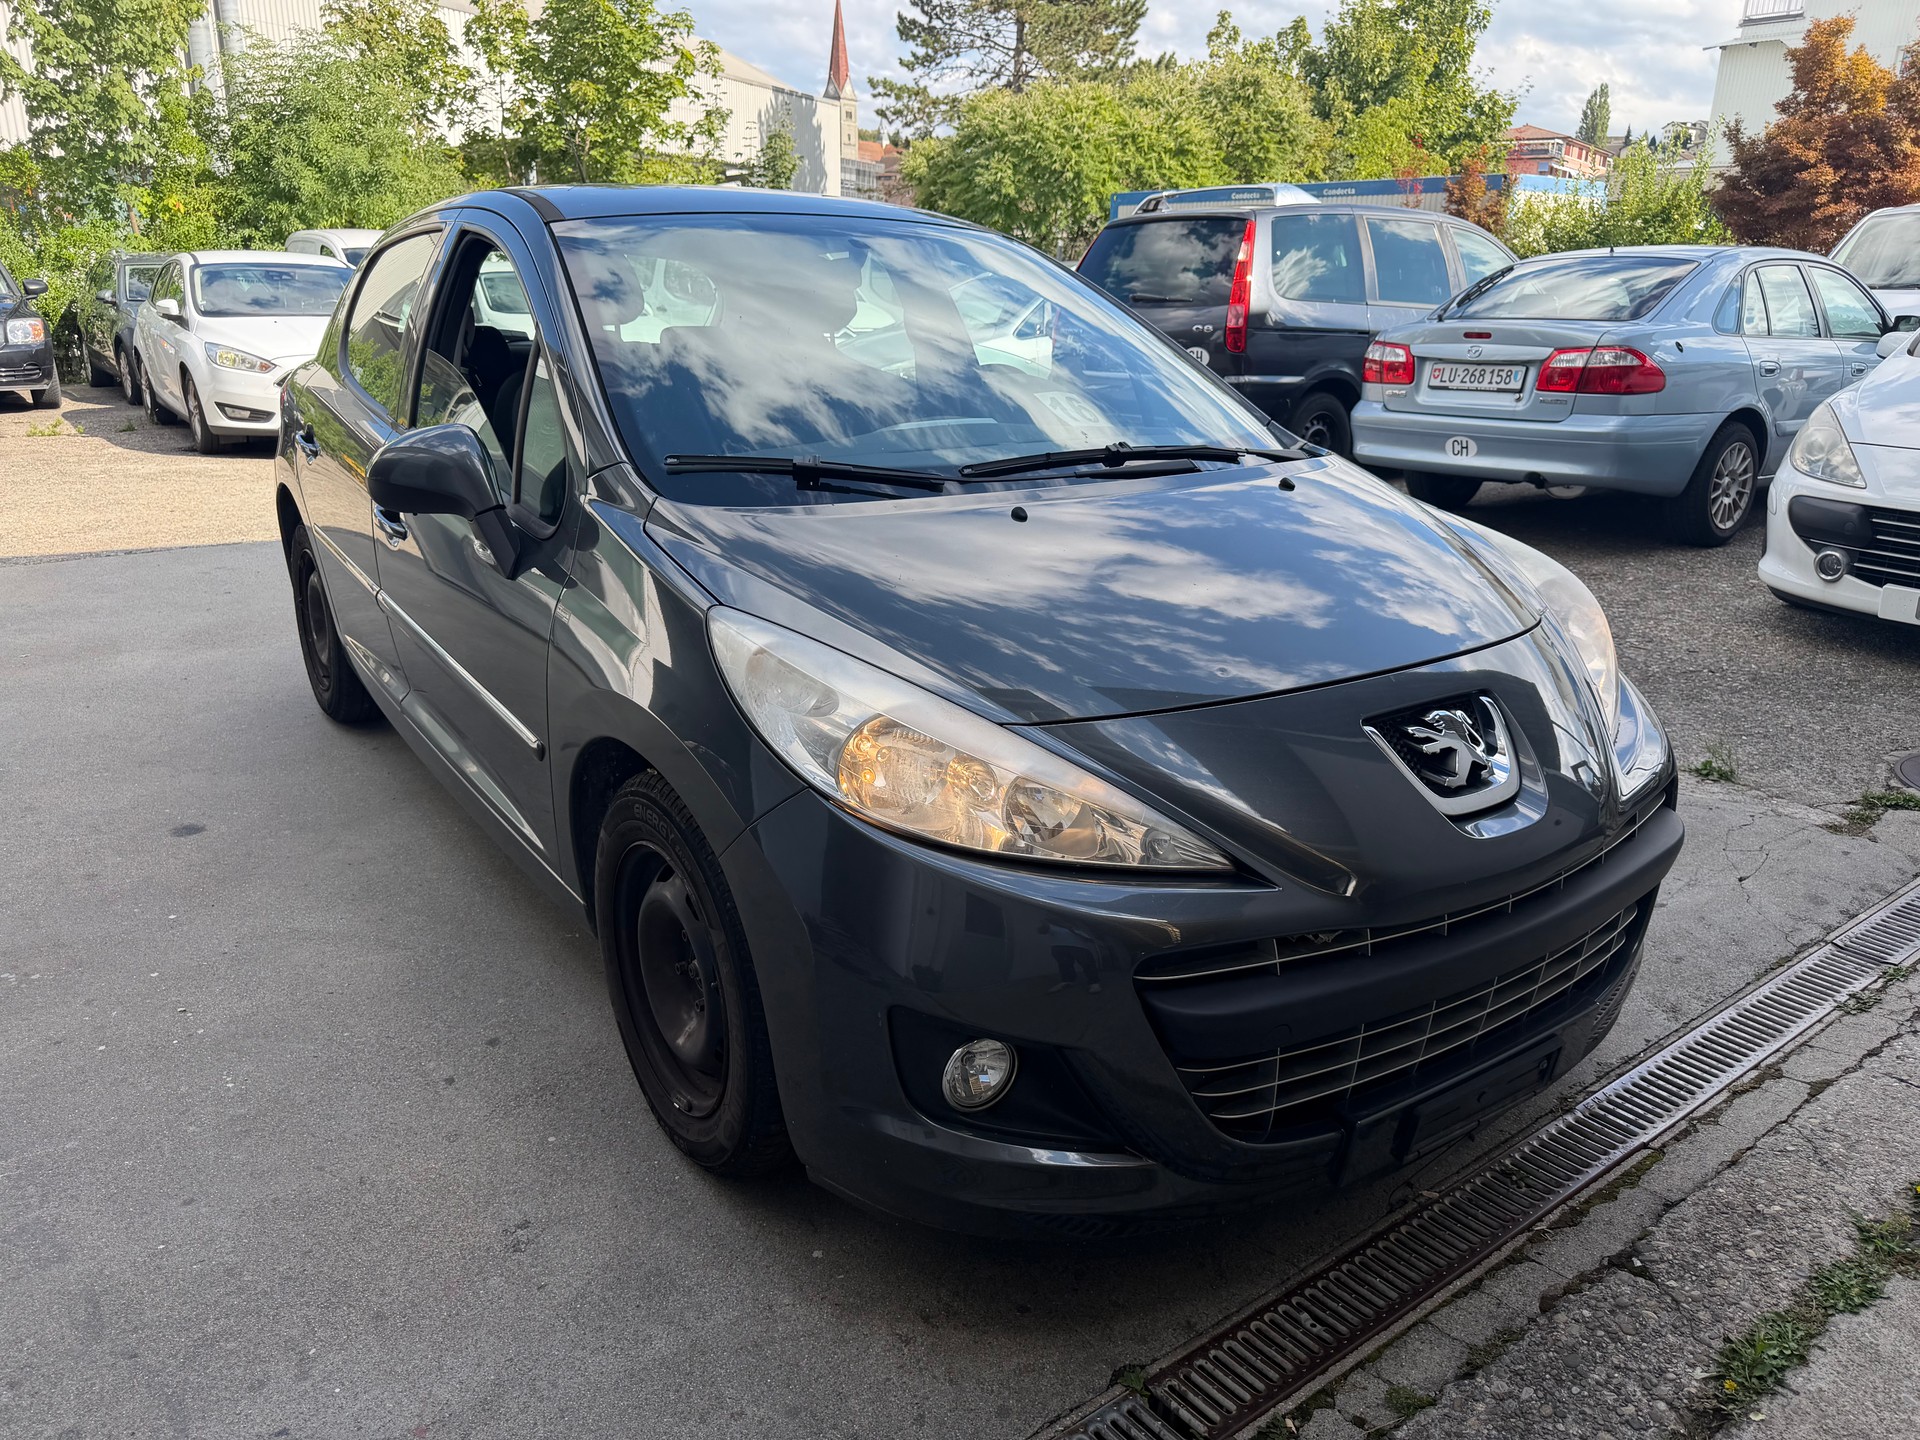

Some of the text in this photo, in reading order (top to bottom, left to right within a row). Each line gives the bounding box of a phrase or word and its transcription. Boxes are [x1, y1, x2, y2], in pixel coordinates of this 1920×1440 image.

[1231, 192, 1260, 200] Condecta
[1451, 439, 1469, 457] CH
[633, 803, 675, 843] ENERGY
